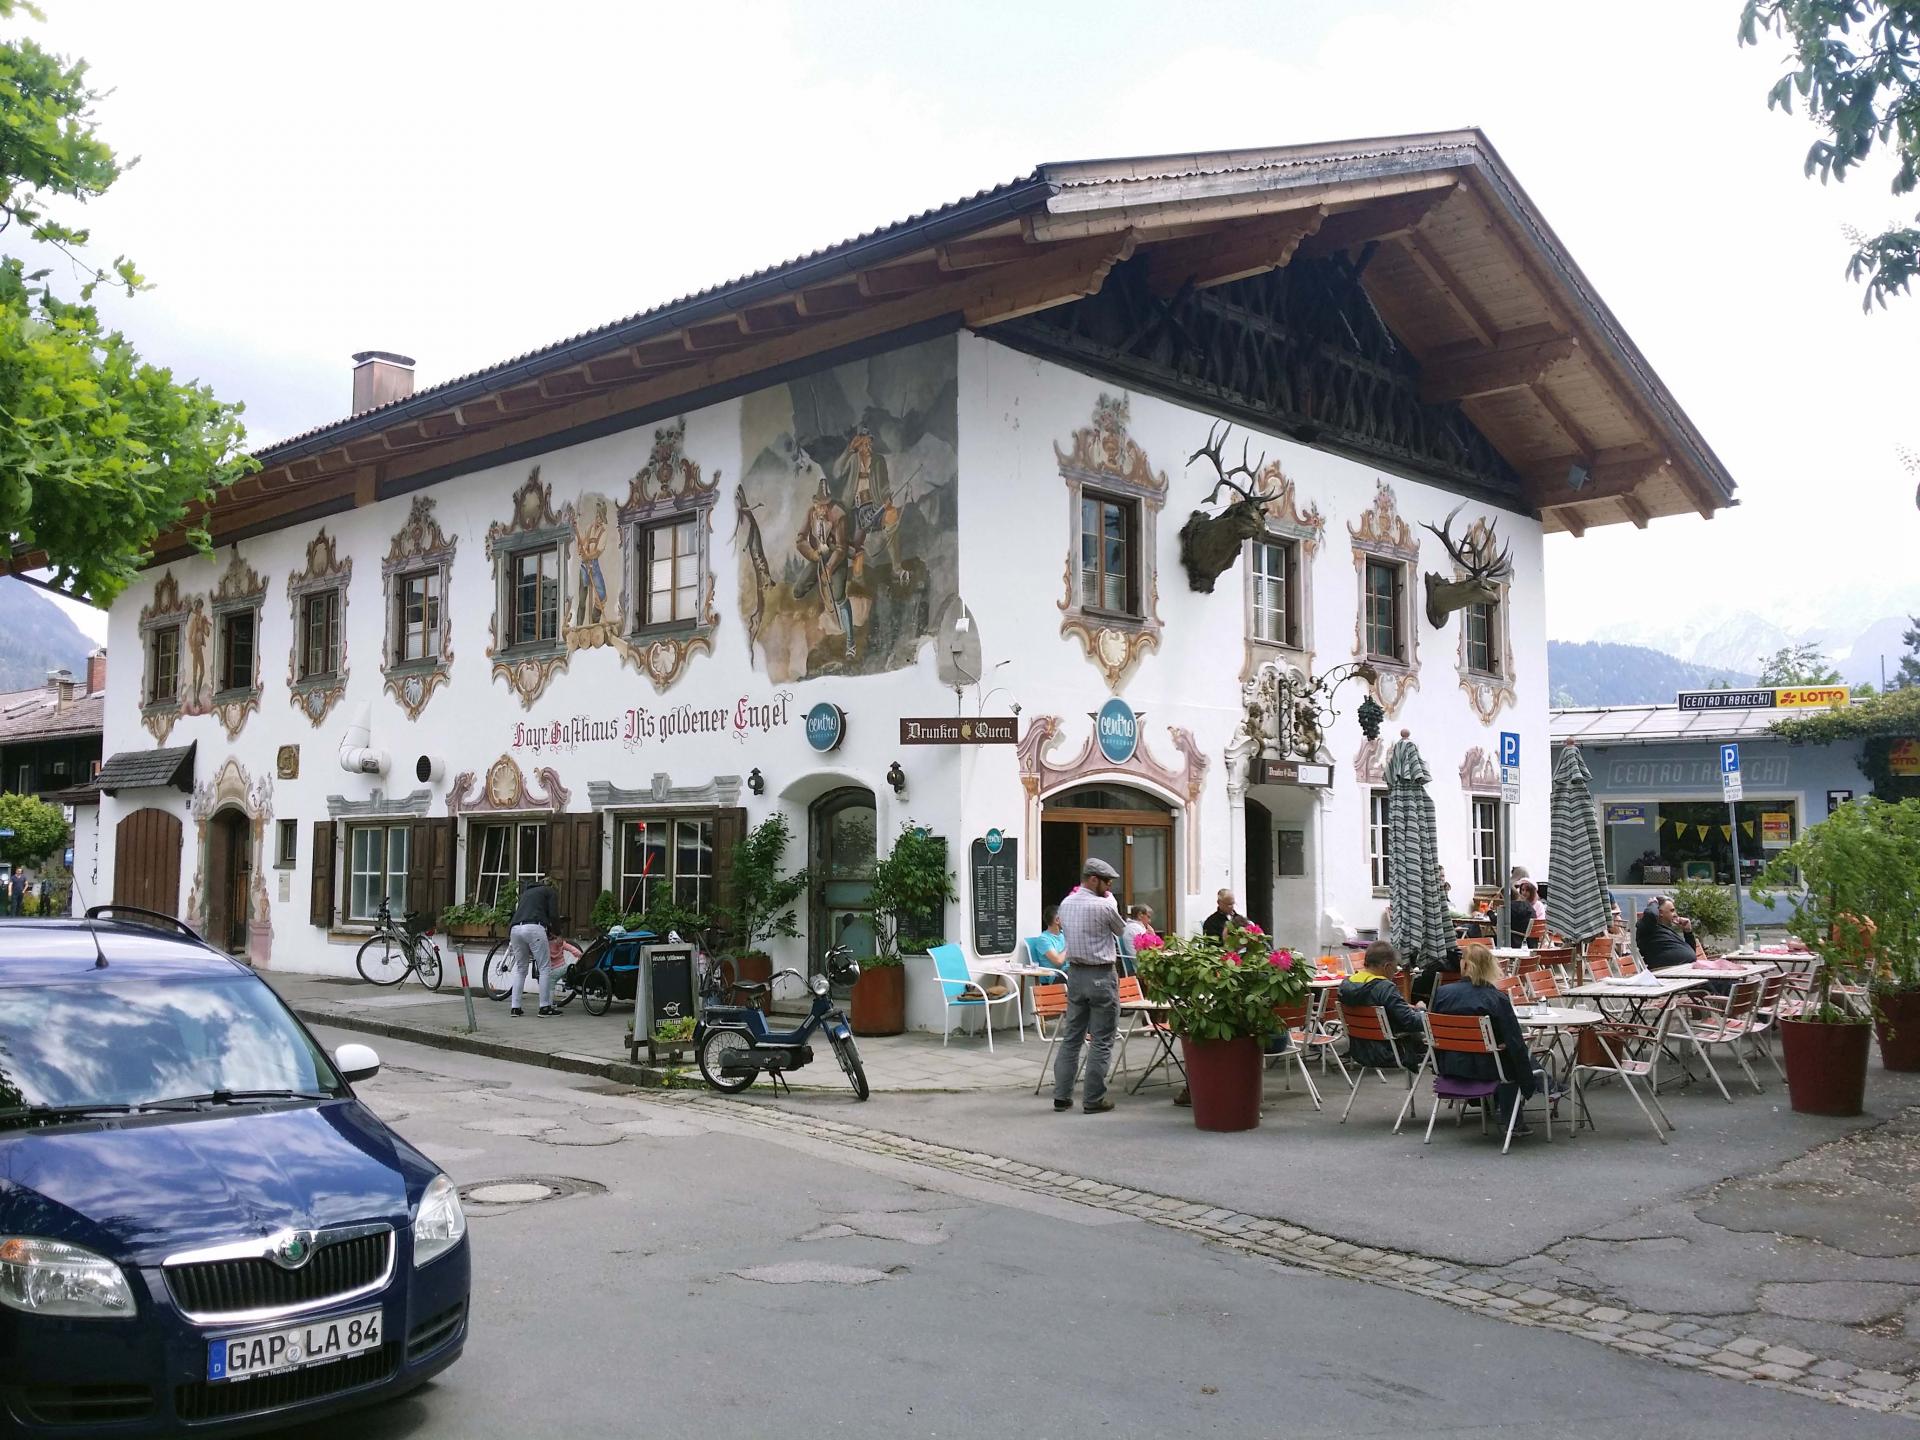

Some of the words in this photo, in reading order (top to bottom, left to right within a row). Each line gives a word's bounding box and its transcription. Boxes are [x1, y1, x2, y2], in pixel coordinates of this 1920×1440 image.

[1685, 695, 1720, 708] CENTRO
[1723, 692, 1768, 707] TABACCHI
[1800, 690, 1844, 703] LOTTO
[659, 704, 729, 744] goldener
[733, 691, 793, 738] Engel
[808, 713, 837, 733] centro
[1100, 713, 1134, 738] centro
[906, 722, 958, 740] Drunken
[975, 721, 1013, 740] Queen
[1504, 736, 1516, 764] P
[1725, 748, 1735, 772] P
[1891, 757, 1919, 766] OTTO
[228, 1335, 286, 1371] GAP
[305, 1325, 341, 1357] LA
[347, 1315, 379, 1347] 84
[214, 1362, 222, 1373] D
